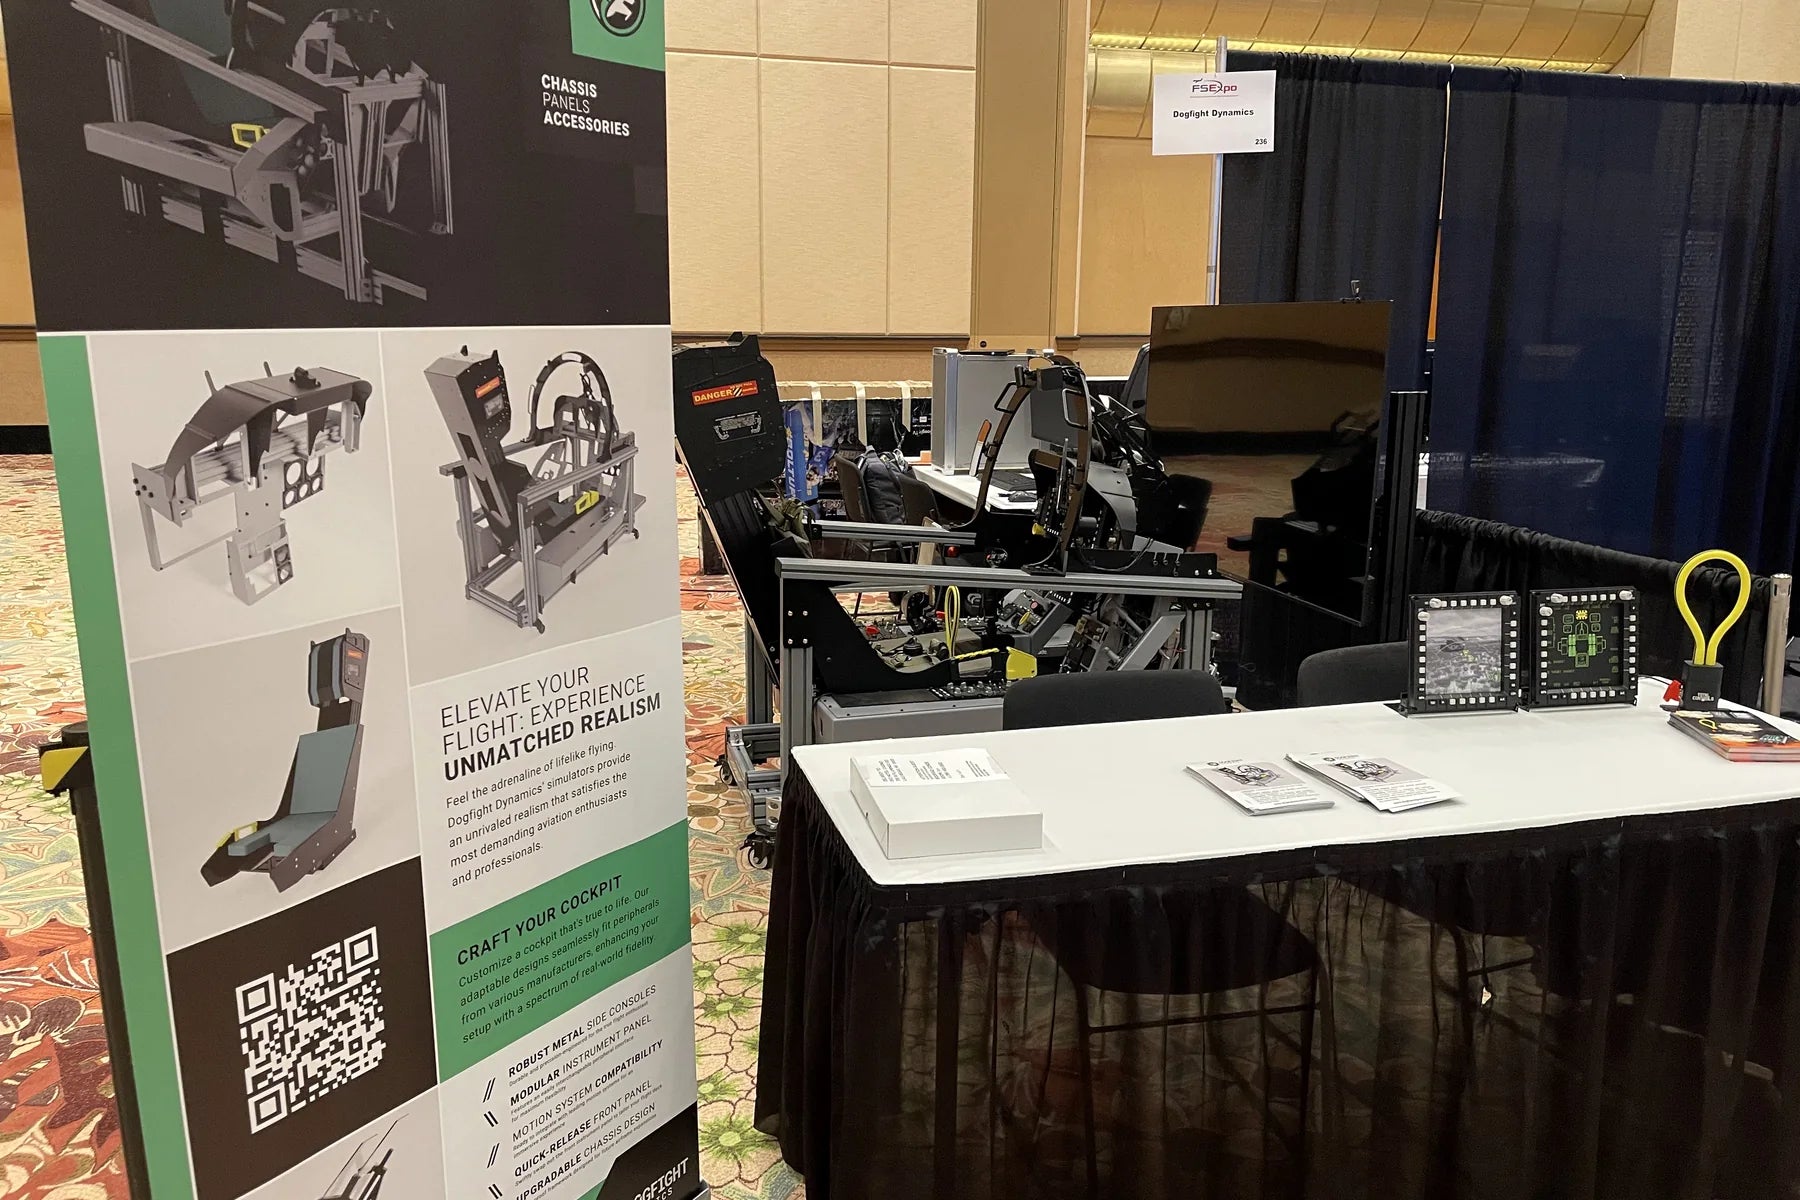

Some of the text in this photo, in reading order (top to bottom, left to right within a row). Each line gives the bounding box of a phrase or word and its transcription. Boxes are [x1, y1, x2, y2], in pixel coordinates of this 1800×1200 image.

[541, 73, 598, 98] CHASSIS
[542, 91, 590, 114] PANELS
[543, 110, 630, 137] ACCESSORIES
[1173, 108, 1254, 119] Dogfight Dynamics
[694, 389, 732, 402] DANGER
[441, 666, 589, 728] ELEVATE YOUR
[443, 673, 646, 755] FLIGHT: EXPERIENCE
[444, 692, 660, 781] UNMATCHED REALISM
[446, 790, 469, 809] Feel
[471, 786, 488, 799] the
[490, 766, 541, 792] adrenaline
[543, 759, 553, 772] of
[555, 750, 586, 767] lifelike
[447, 803, 492, 829] Dogfight
[546, 765, 594, 790] simulators
[597, 752, 630, 773] provide
[449, 772, 627, 848] an unrivaled realism that satisfies the
[450, 789, 627, 868] most demanding aviation enthusiasts
[452, 869, 472, 887] and
[457, 875, 622, 965] CRAFT YOUR COCKPIT
[458, 955, 512, 987] Customize
[514, 951, 521, 959] a
[523, 931, 557, 955] cockpit
[585, 909, 602, 923] true
[604, 904, 613, 914] to
[634, 887, 649, 899] Our
[460, 899, 659, 1007] adaptable designs seamlessly fit peripherals
[461, 1006, 486, 1025] from
[488, 986, 524, 1010] various
[595, 925, 639, 953] enhancing
[640, 915, 658, 933] your
[462, 1022, 491, 1044] setup
[493, 1008, 514, 1026] with
[517, 1005, 523, 1014] a
[525, 979, 568, 1009] spectrum
[570, 973, 579, 984] of
[581, 951, 623, 977] real-world
[508, 984, 656, 1078] ROBUST METAL SIDE CONSOLES
[510, 1015, 651, 1106] MODULAR INSTRUMENT PANEL
[512, 1039, 662, 1142] MOTION SYSTEM COMPATIBILITY
[514, 1081, 651, 1177] QUICK-RELEASE FRONT PANEL
[516, 1102, 654, 1200] UPGRADABLE CHASSIS DESIGN
